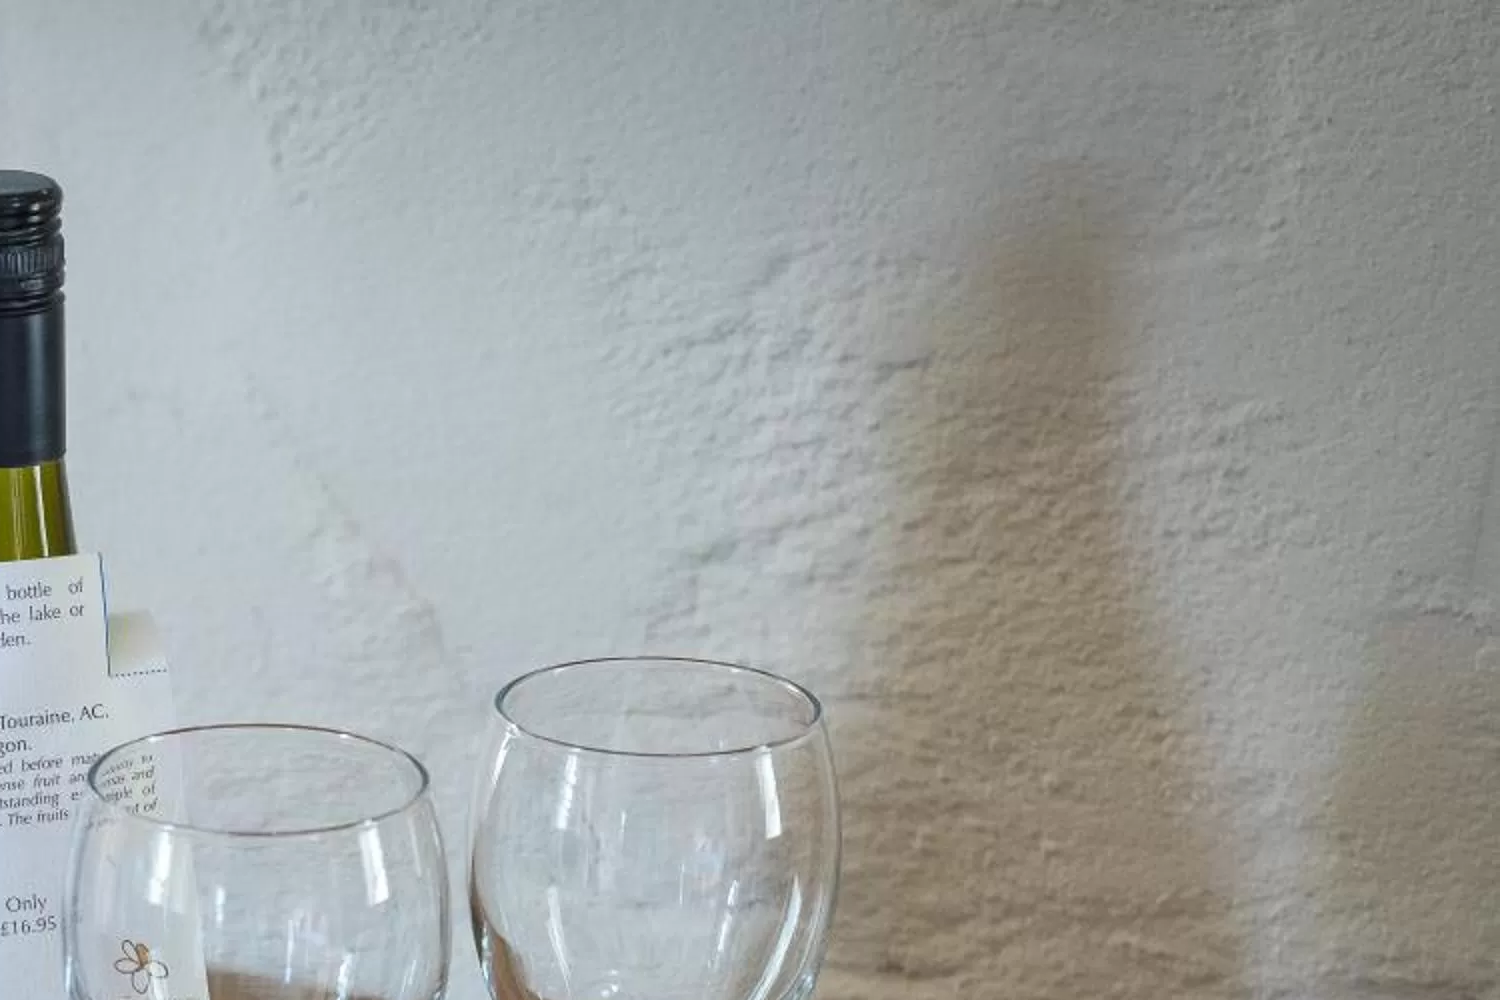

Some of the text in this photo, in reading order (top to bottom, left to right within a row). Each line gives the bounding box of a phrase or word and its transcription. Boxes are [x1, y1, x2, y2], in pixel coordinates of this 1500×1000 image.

[5, 580, 52, 601] bottle
[67, 577, 84, 594] of
[29, 605, 61, 621] lake
[69, 604, 84, 617] or
[22, 756, 63, 773] before
[32, 771, 61, 788] fruit
[7, 814, 33, 827] The
[5, 893, 48, 916] Only
[0, 915, 57, 937] £16.95
